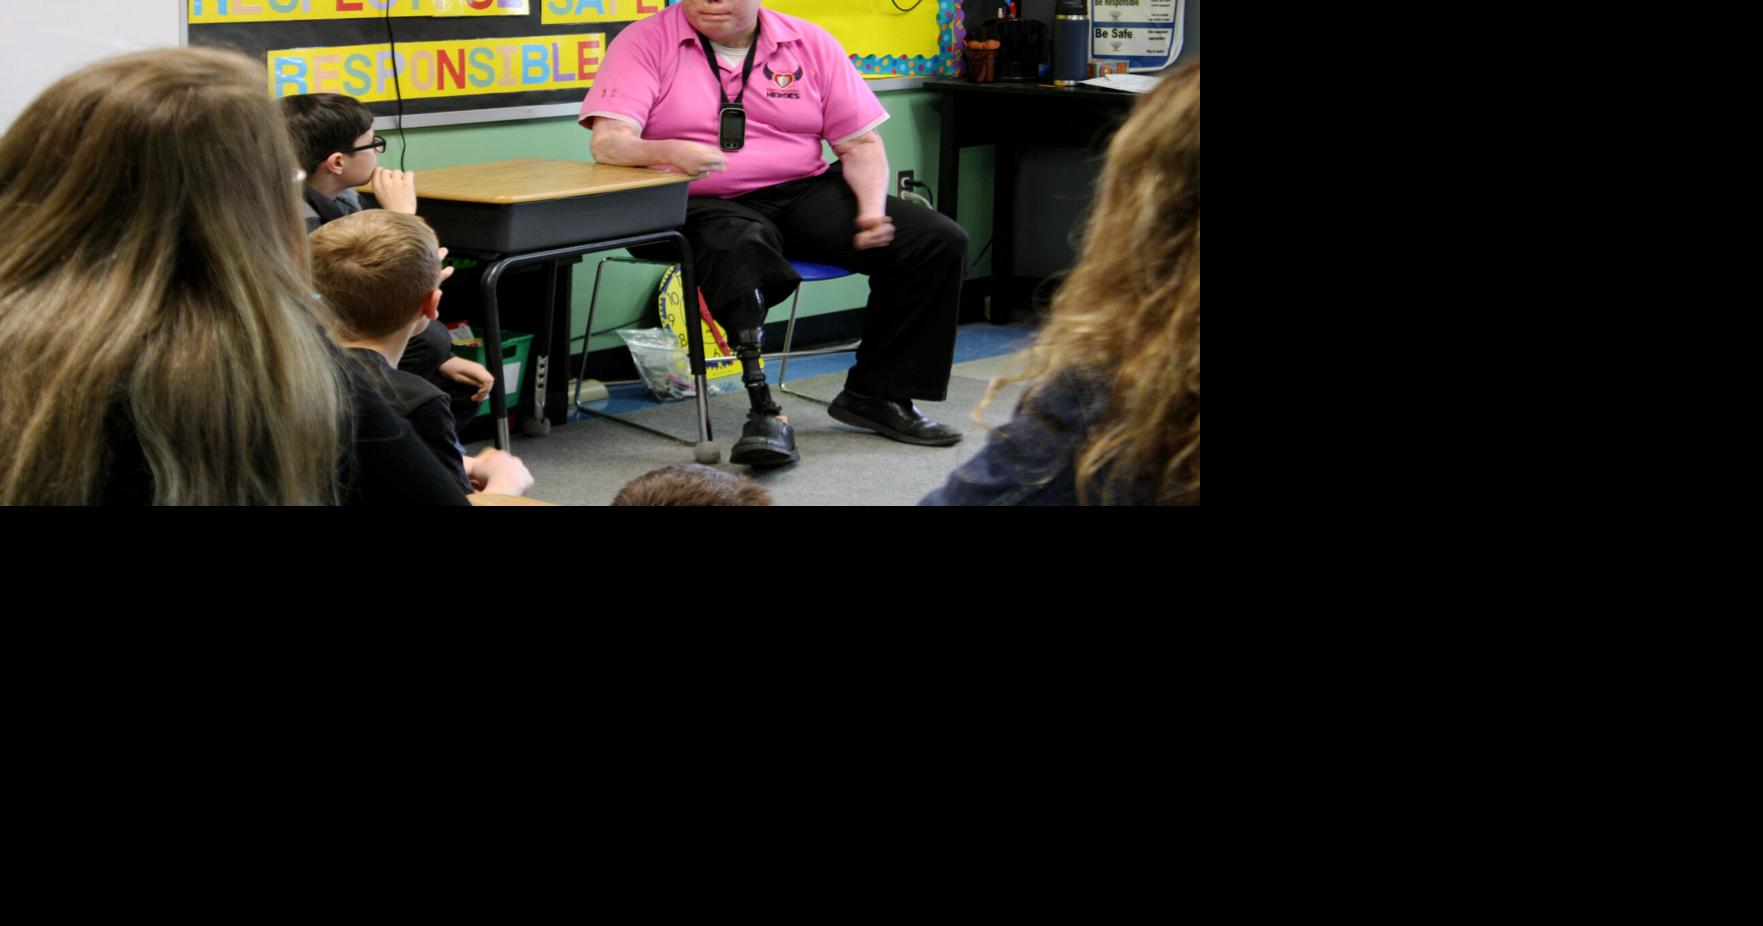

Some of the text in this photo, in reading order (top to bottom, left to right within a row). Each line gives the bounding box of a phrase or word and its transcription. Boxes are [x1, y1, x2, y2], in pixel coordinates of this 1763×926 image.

[1095, 28, 1133, 38] Be Safe
[273, 40, 600, 99] RESPONSIBLE
[679, 333, 687, 347] 8
